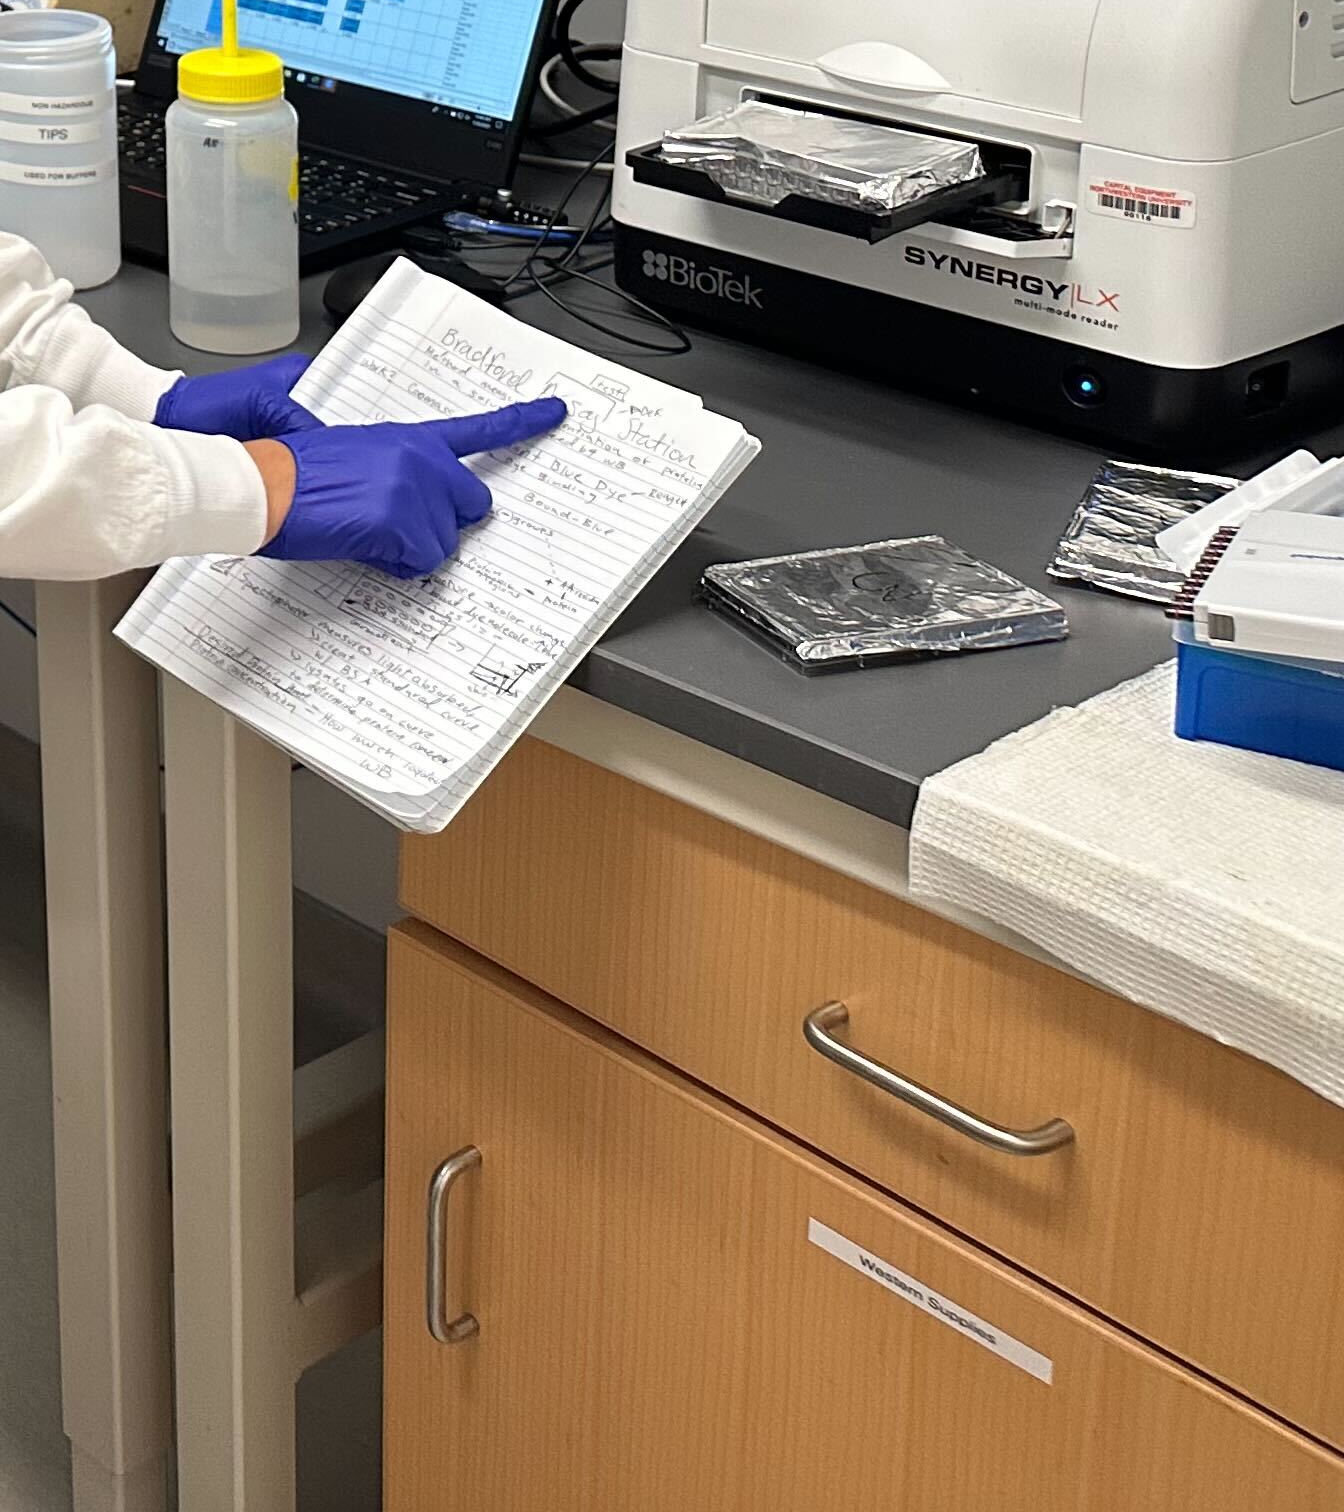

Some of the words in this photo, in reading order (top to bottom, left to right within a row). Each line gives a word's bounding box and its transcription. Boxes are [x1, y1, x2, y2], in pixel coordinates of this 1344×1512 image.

[38, 127, 70, 141] TIPS
[23, 170, 47, 181] USED
[47, 172, 65, 181] FOR
[66, 170, 98, 181] BUFFERS
[668, 254, 764, 310] BioTek
[904, 245, 1070, 301] SYNERGY
[1014, 296, 1077, 321] multi-mode
[1080, 314, 1120, 332] reader
[440, 327, 534, 393] Bradford
[617, 417, 697, 470] Station
[550, 459, 584, 486] Blue
[595, 478, 628, 504] Dye
[858, 1254, 925, 1302] Western
[926, 1295, 998, 1346] Supplies
